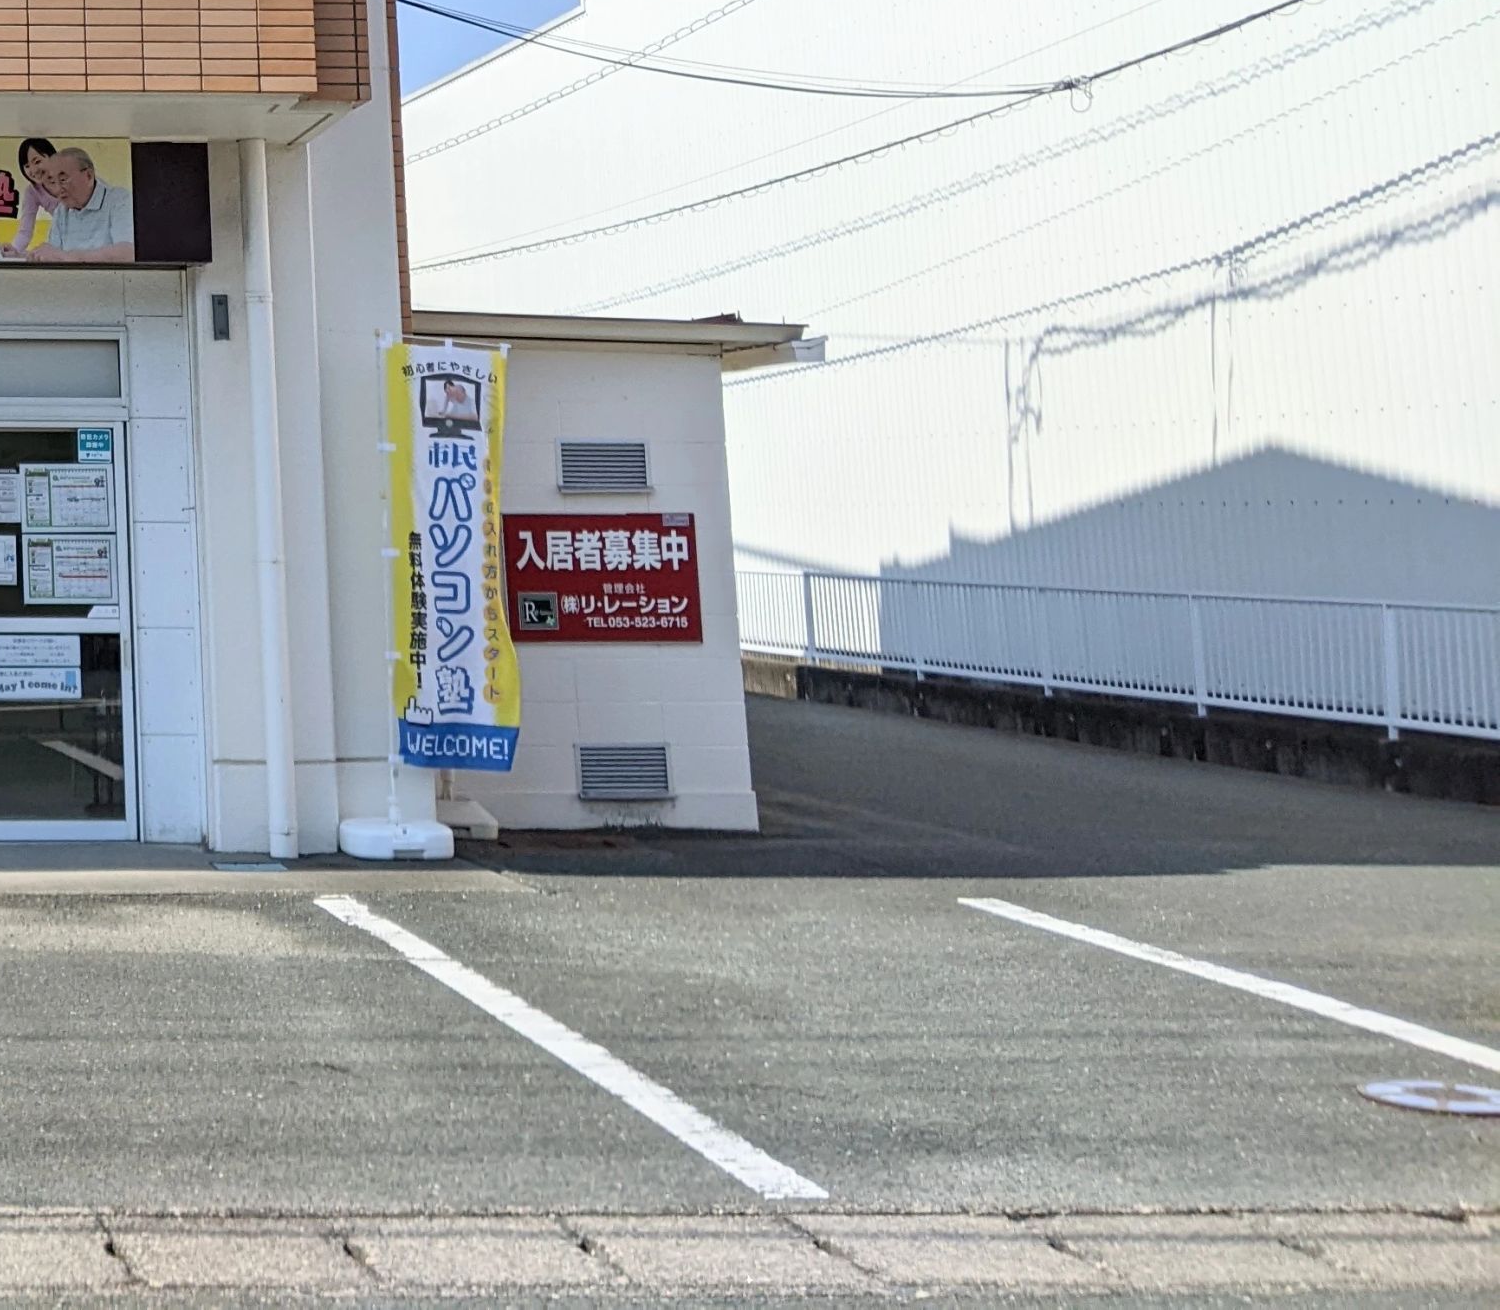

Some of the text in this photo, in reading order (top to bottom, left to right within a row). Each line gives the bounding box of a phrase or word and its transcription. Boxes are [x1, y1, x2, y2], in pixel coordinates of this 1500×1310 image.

[401, 362, 498, 384] 初心者にやさしい
[516, 530, 690, 571] 入居者募集中
[429, 474, 477, 716] パソコン塾
[28, 680, 58, 690] come
[407, 732, 509, 761] WELCOME!
